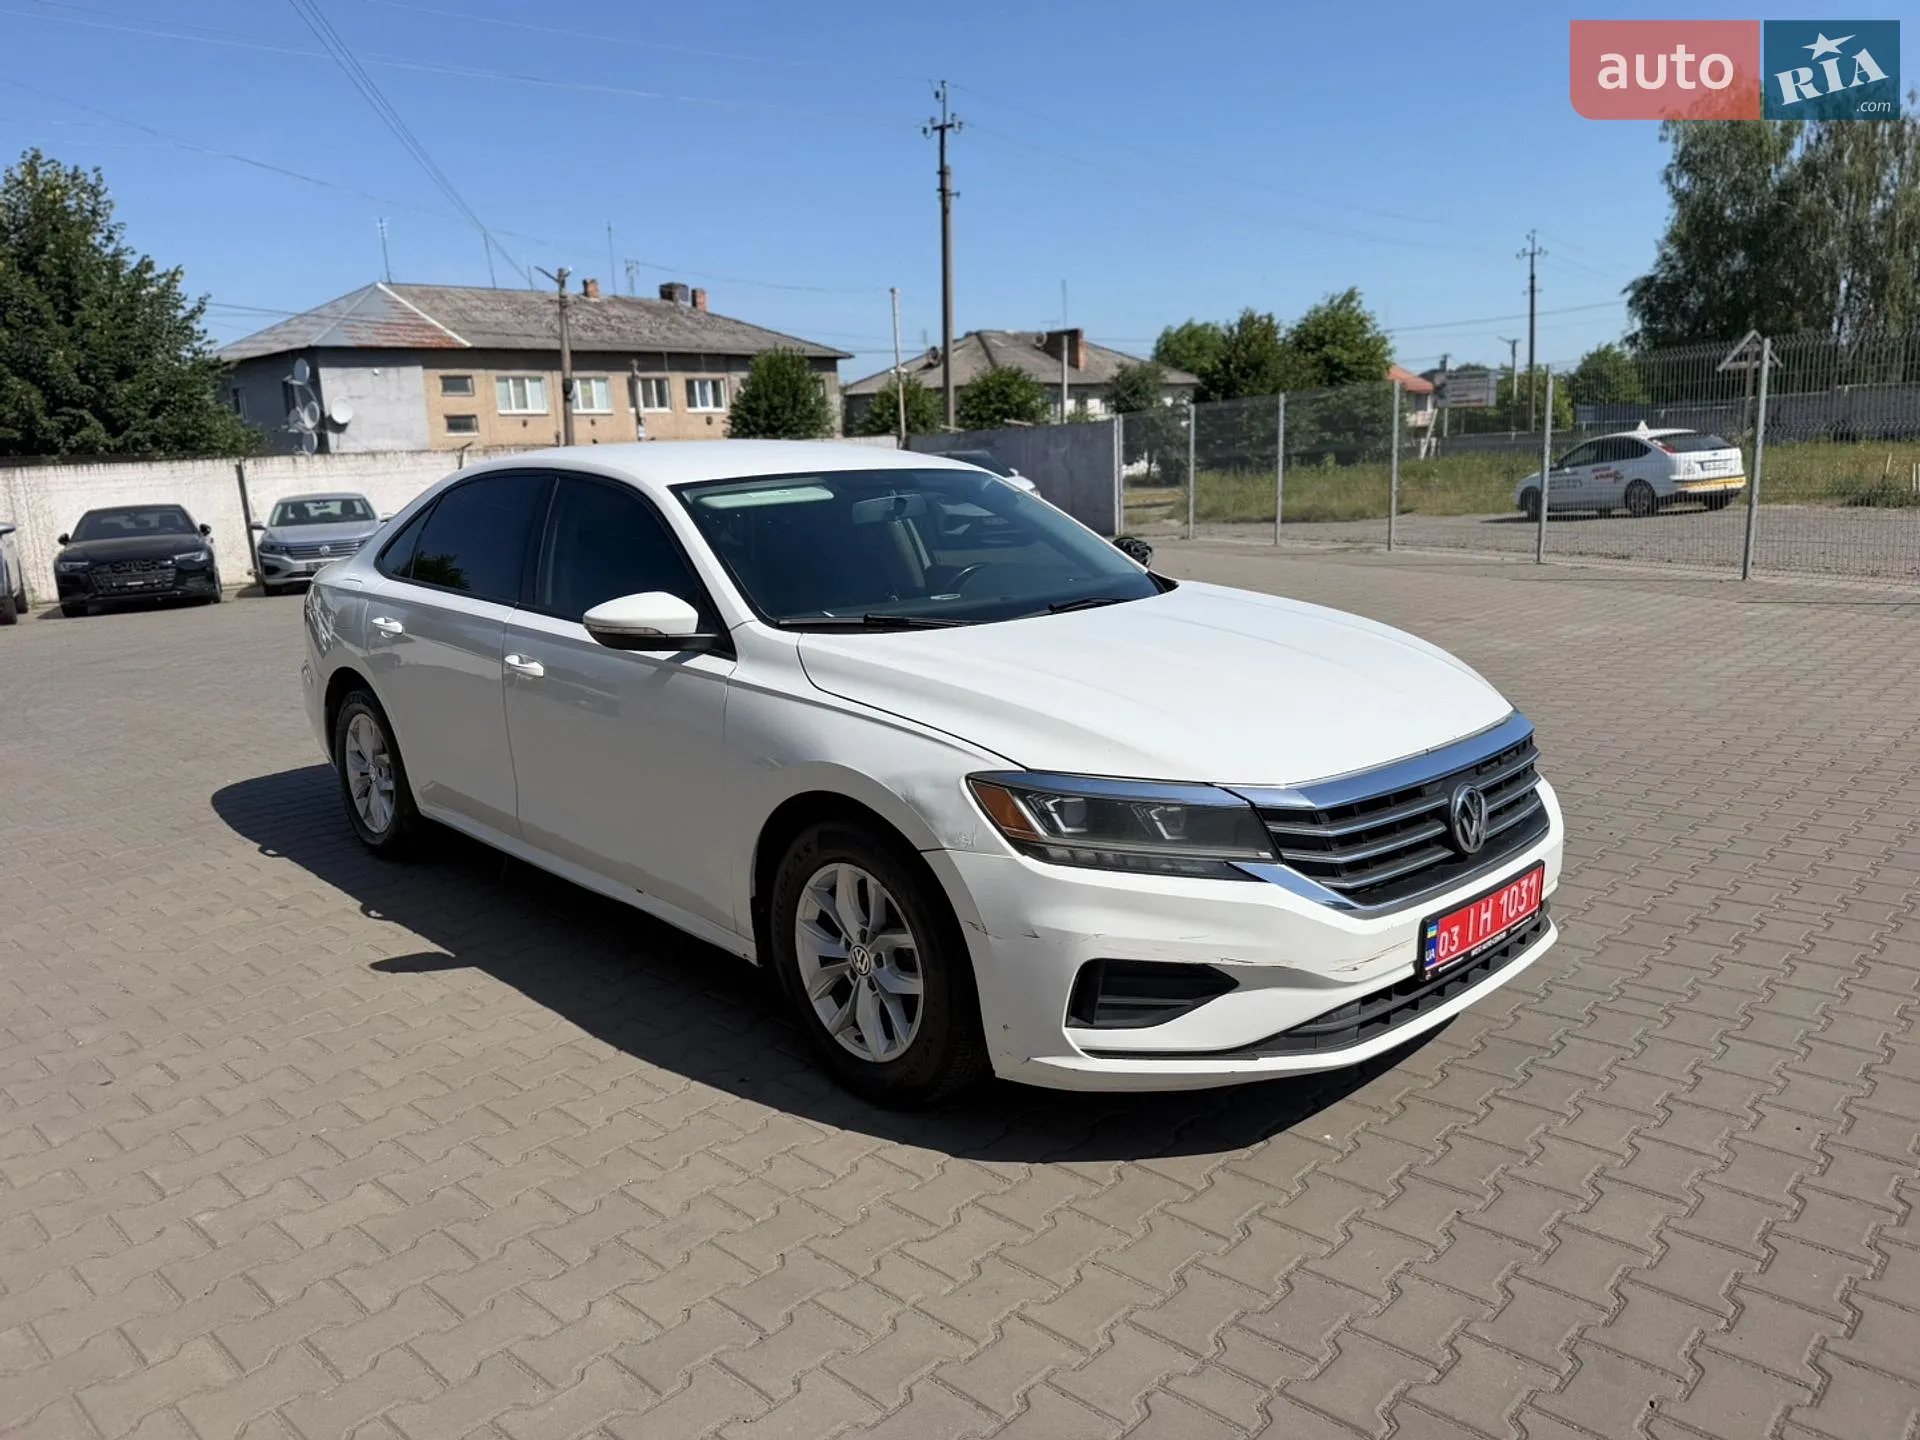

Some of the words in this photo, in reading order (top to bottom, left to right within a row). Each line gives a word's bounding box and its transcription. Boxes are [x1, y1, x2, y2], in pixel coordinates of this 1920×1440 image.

[1438, 925, 1460, 957] 03
[1499, 875, 1538, 922] 1031
[1425, 948, 1435, 962] UA
